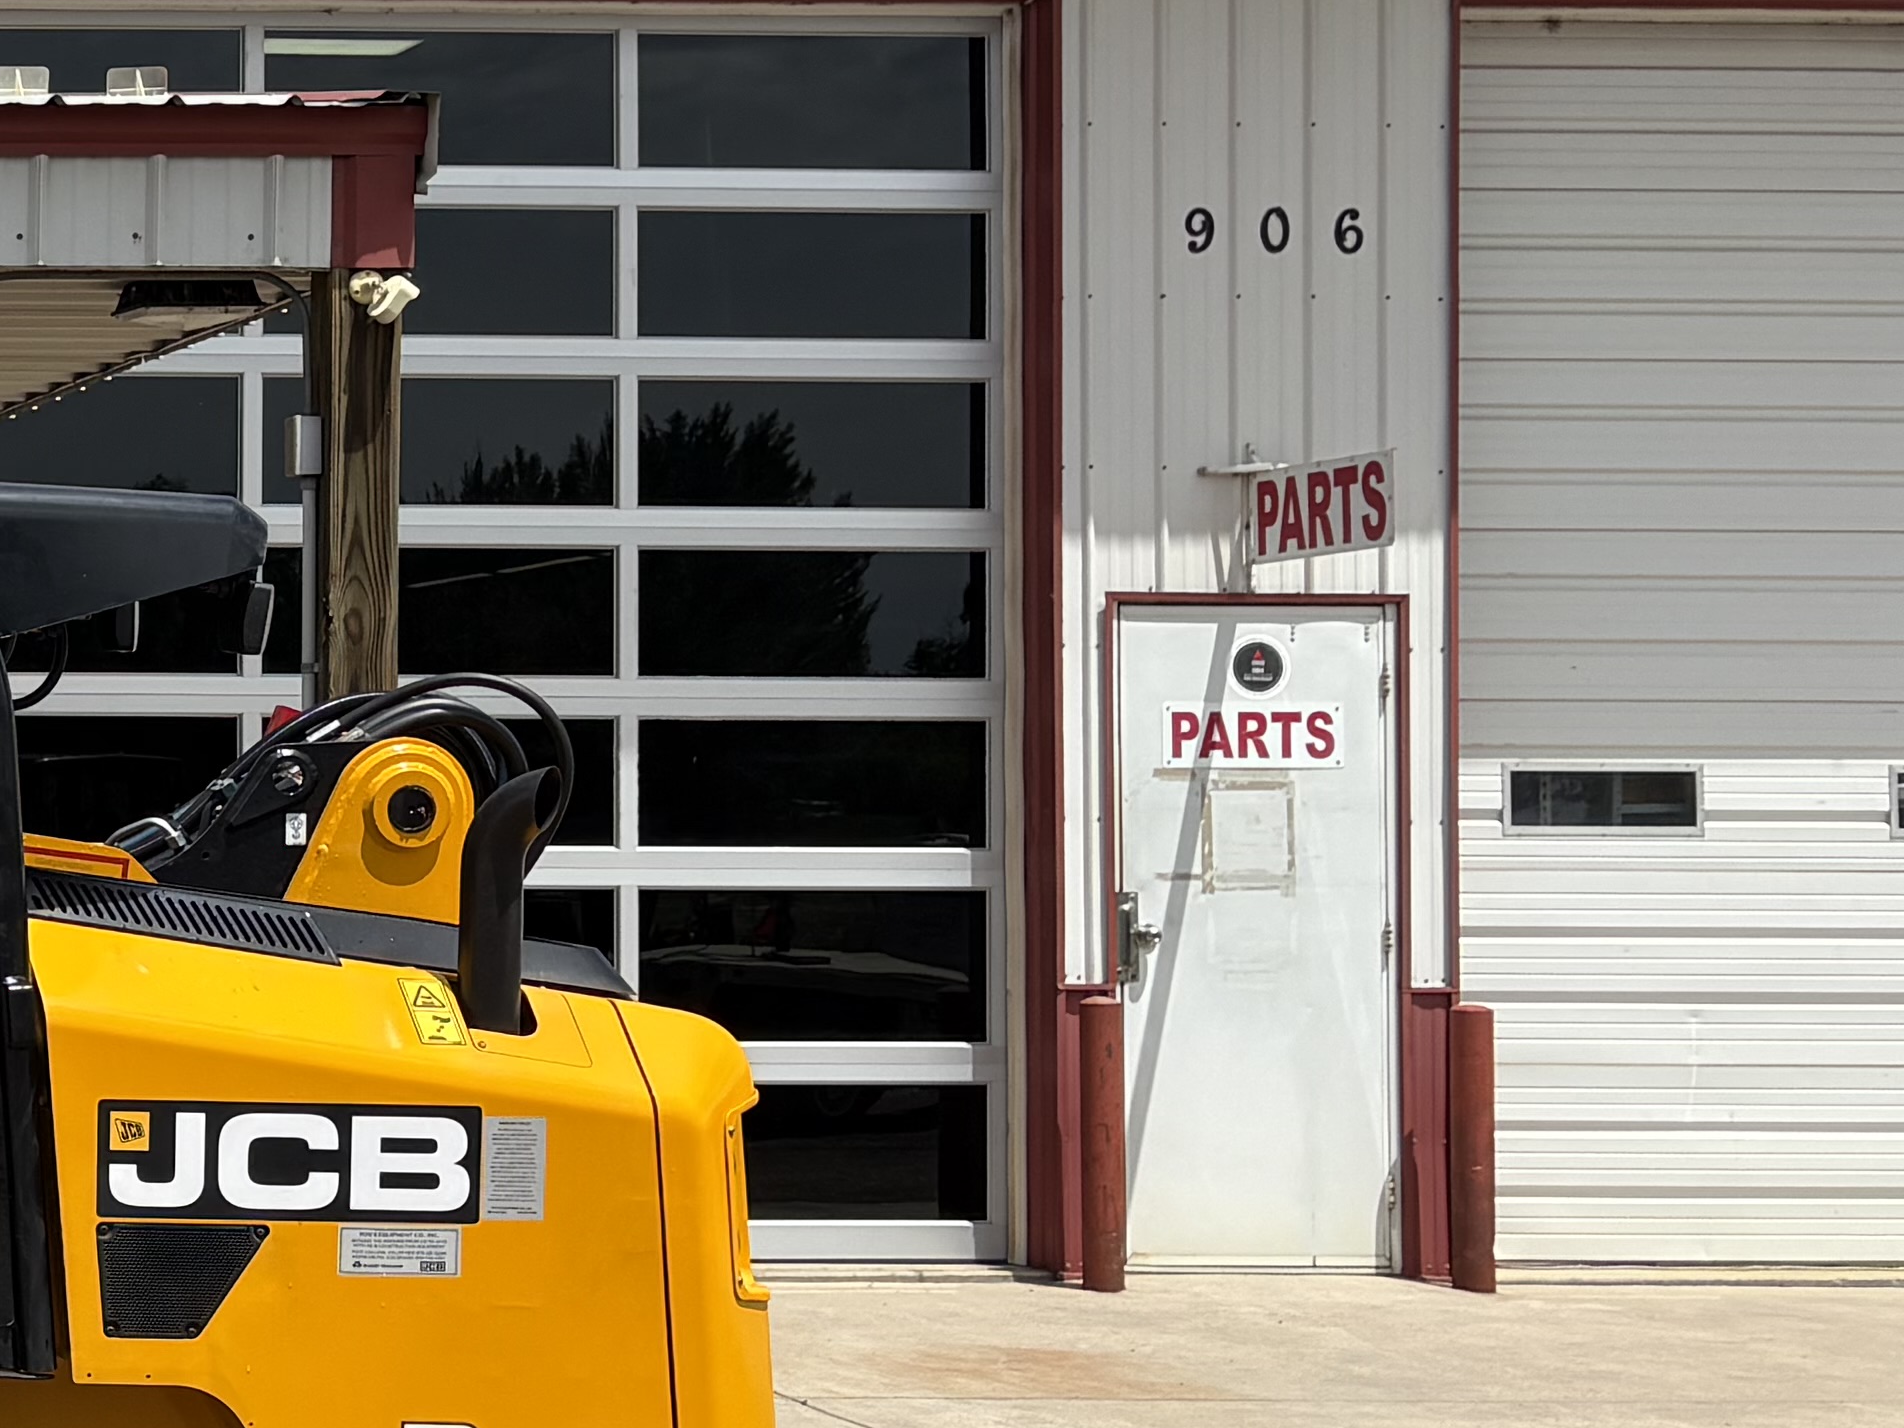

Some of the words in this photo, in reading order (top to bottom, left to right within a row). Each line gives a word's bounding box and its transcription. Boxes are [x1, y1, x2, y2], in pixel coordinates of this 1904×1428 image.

[1185, 206, 1364, 255] 906
[1256, 460, 1387, 557] PARTS
[1169, 710, 1336, 760] PARTS
[118, 1120, 144, 1142] JCB
[108, 1112, 471, 1212] JCB
